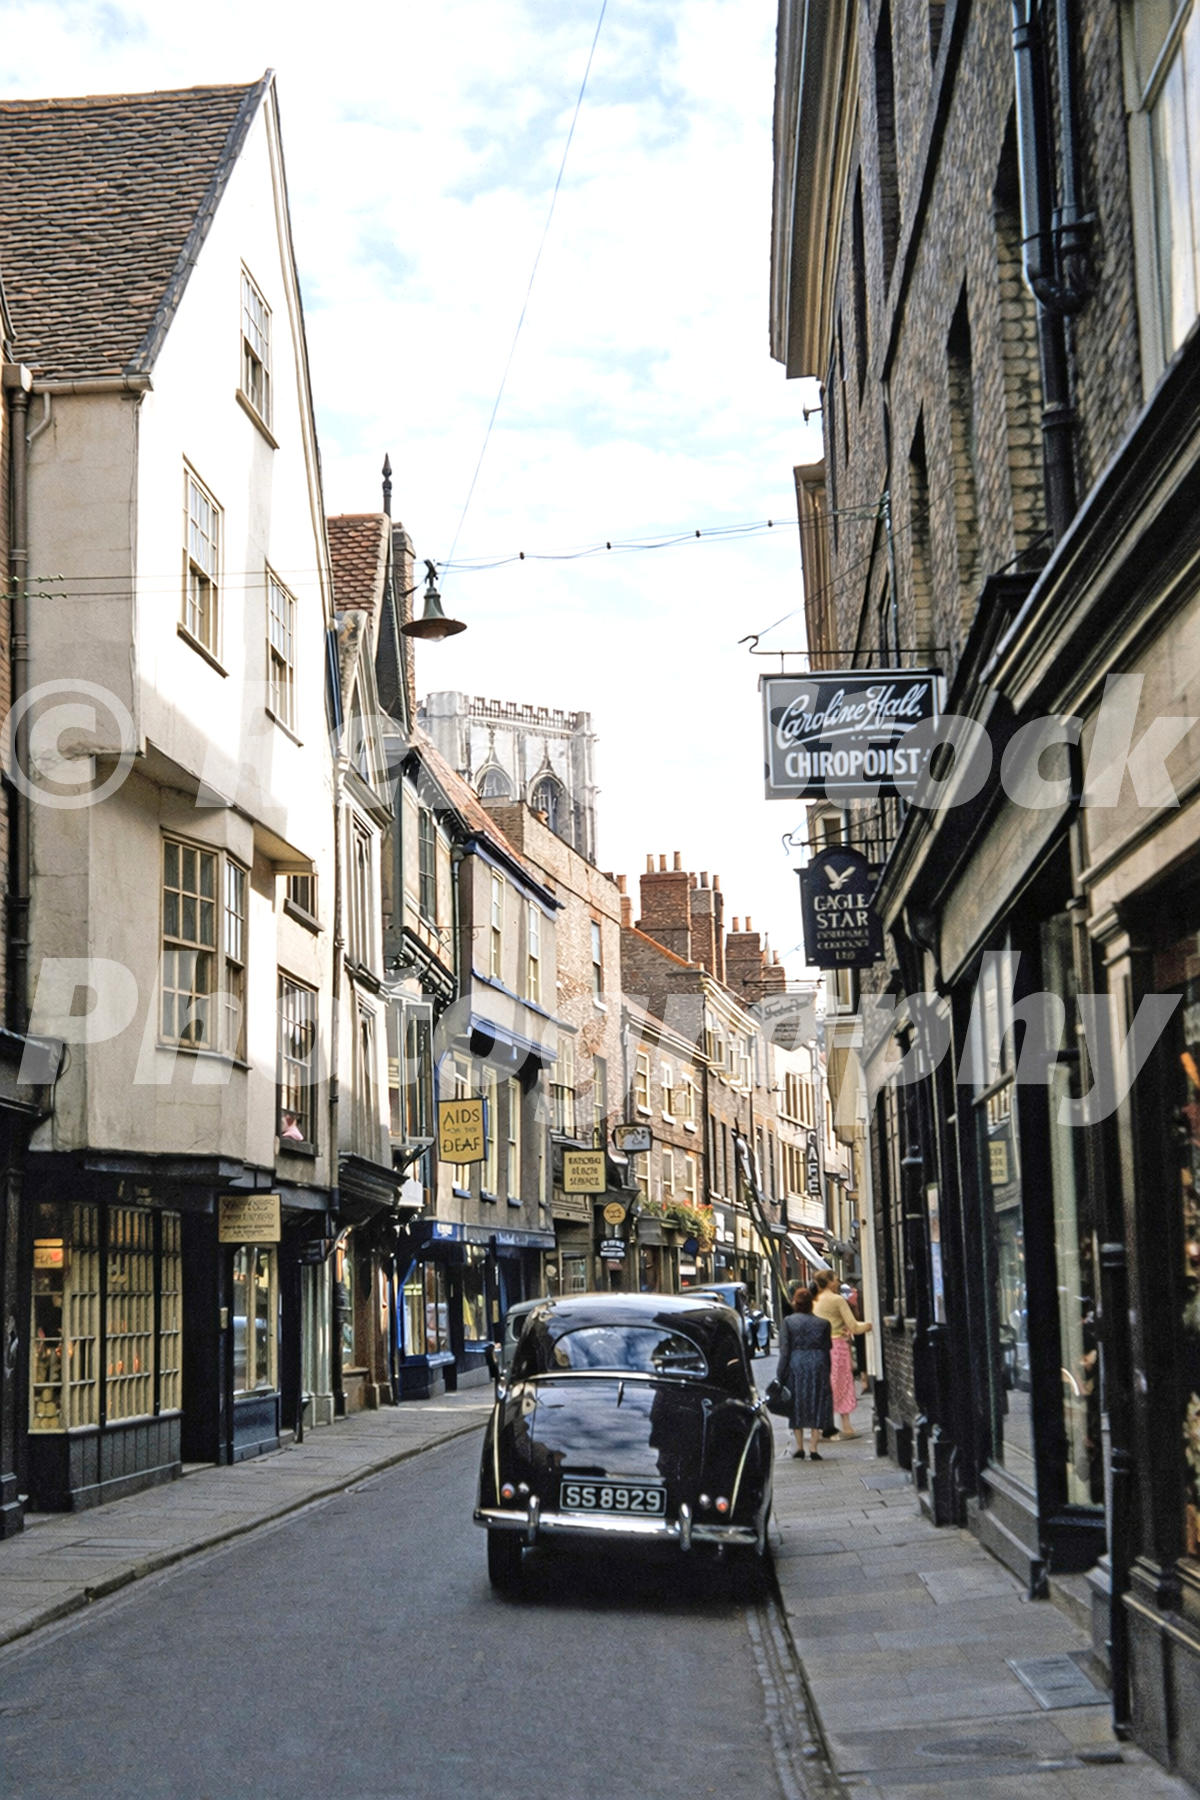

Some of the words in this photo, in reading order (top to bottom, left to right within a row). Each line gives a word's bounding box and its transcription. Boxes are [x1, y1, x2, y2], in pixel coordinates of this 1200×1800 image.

[776, 688, 866, 749] Caroline
[814, 893, 869, 911] EAGLE
[816, 911, 868, 929] STAR
[443, 1108, 480, 1125] AIDS
[443, 1136, 480, 1153] DEAF
[807, 1131, 820, 1193] CAFE
[566, 1486, 596, 1508] SS
[600, 1488, 661, 1512] 8929
